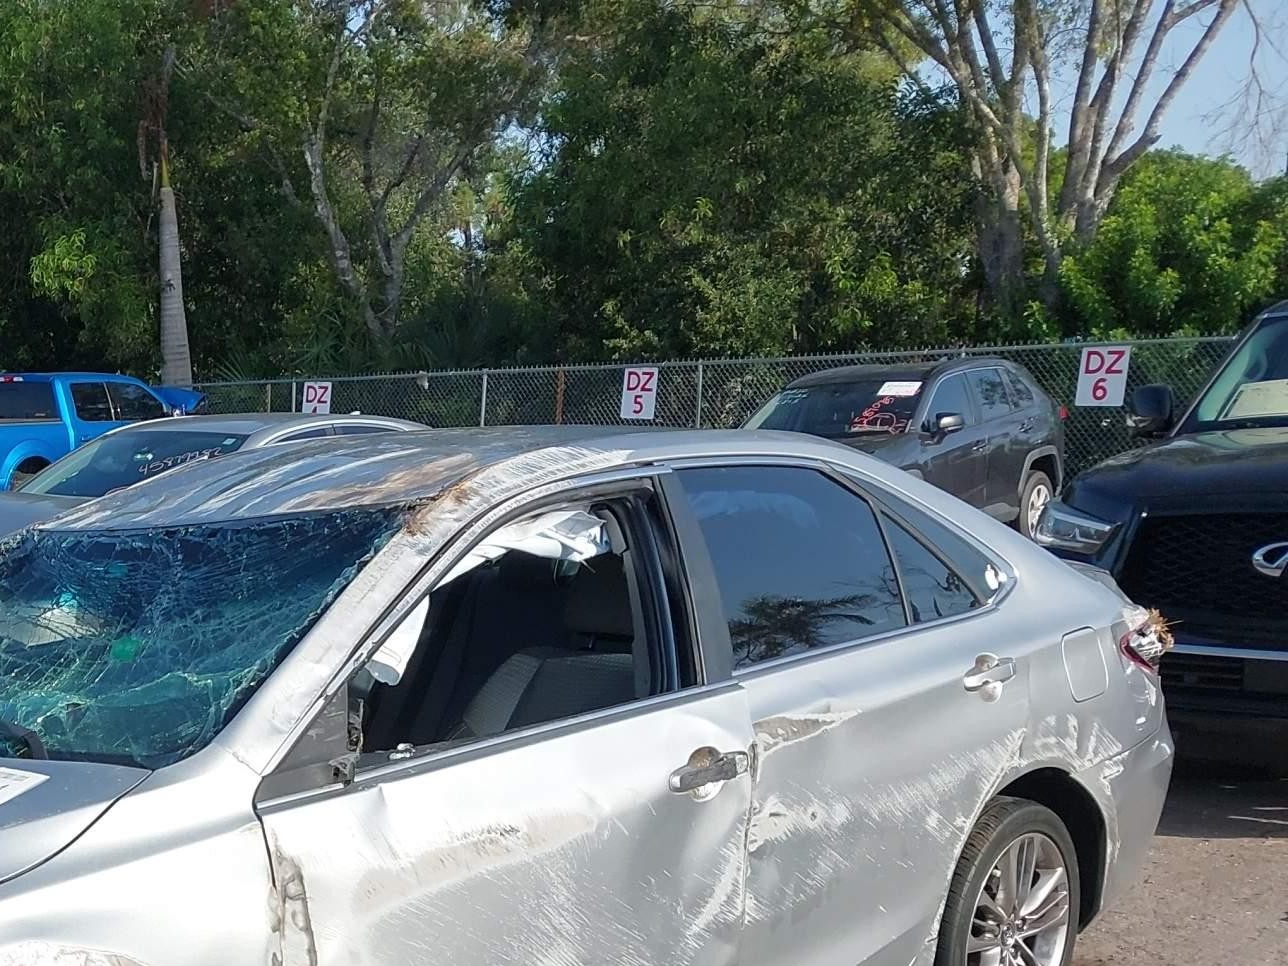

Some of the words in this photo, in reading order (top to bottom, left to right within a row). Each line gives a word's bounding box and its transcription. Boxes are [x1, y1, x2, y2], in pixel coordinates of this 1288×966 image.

[1084, 350, 1126, 375] DZ
[626, 370, 655, 392] DZ
[1092, 377, 1108, 401] 6
[305, 385, 329, 404] DZ
[632, 394, 644, 414] 5
